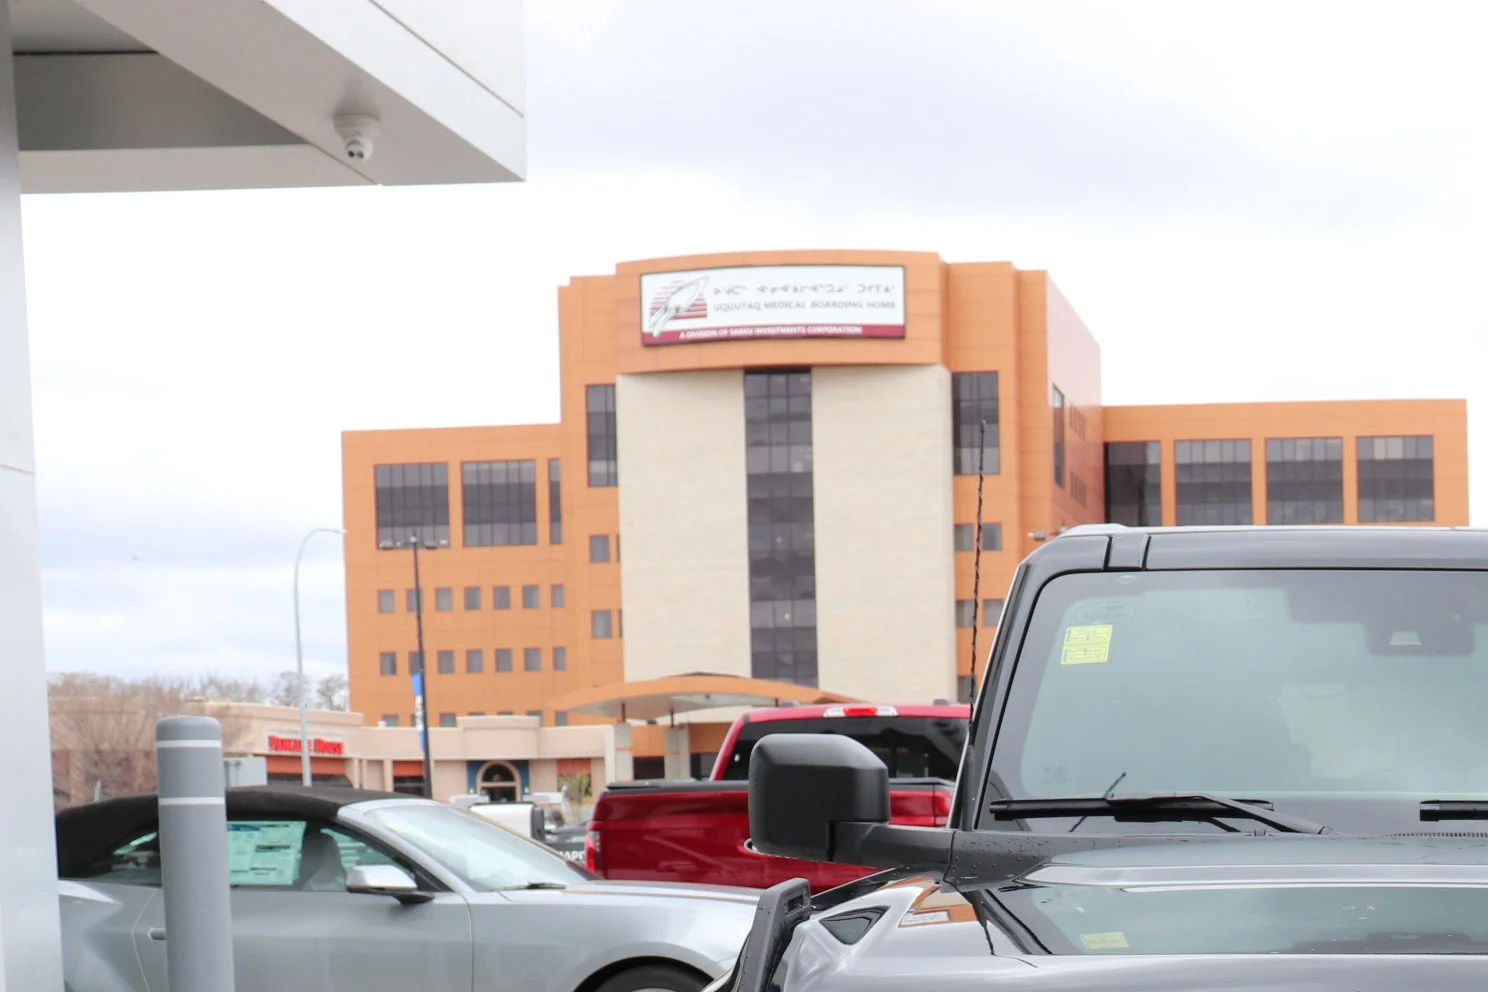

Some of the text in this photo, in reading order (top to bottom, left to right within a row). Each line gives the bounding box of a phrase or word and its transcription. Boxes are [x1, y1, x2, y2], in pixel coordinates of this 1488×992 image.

[764, 300, 806, 309] MEDICAL
[810, 300, 863, 308] BOARDING
[866, 300, 896, 308] HOME
[686, 329, 717, 338] DIVISION
[754, 325, 805, 335] INVESTMENTS
[807, 325, 863, 334] CORPORATION
[270, 735, 313, 752] PANCAE
